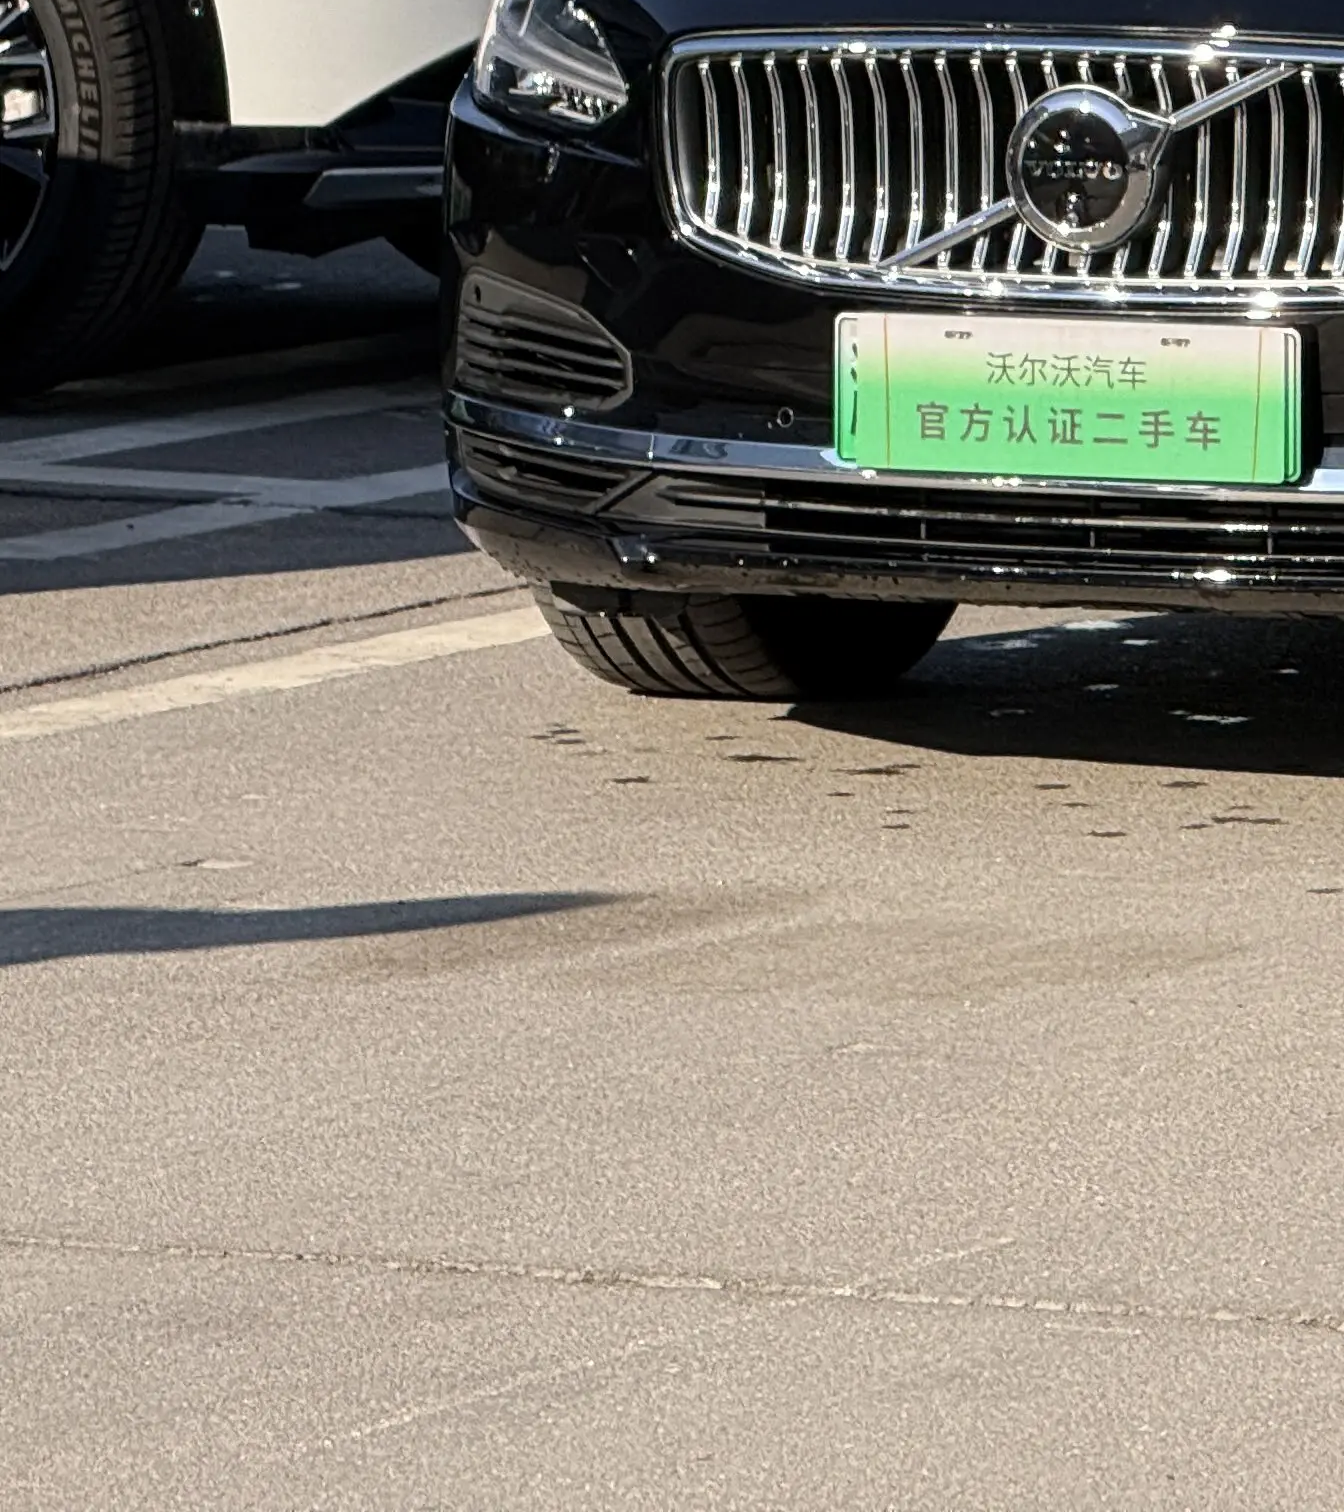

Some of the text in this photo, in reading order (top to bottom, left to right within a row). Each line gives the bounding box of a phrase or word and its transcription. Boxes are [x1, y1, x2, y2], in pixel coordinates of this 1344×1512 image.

[986, 352, 1147, 390] 沃尔沃汽车
[915, 401, 1222, 450] 官方认证二手车
